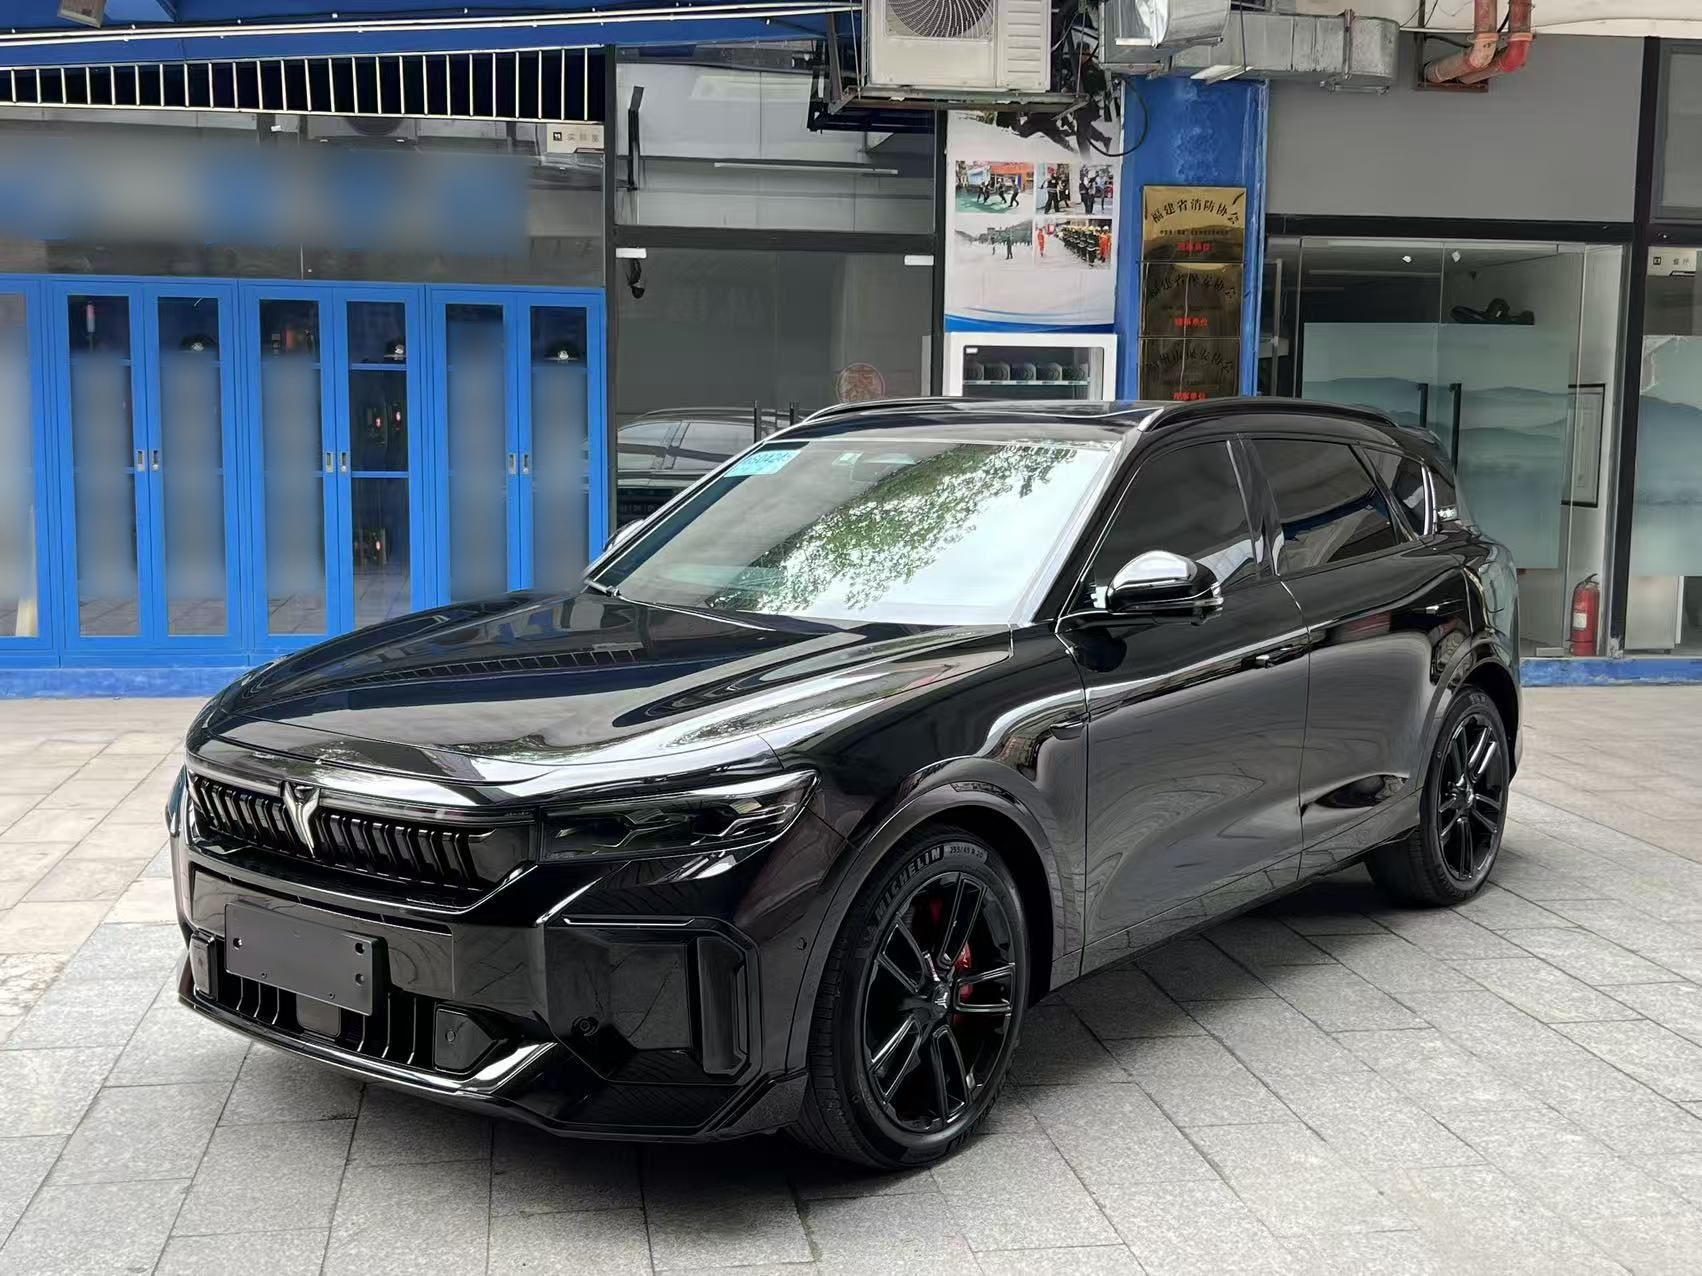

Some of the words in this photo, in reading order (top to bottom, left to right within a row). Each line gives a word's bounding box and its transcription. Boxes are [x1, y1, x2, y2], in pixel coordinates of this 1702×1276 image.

[1151, 198, 1239, 225] 福建省消防协会
[874, 846, 942, 920] MICHELIN
